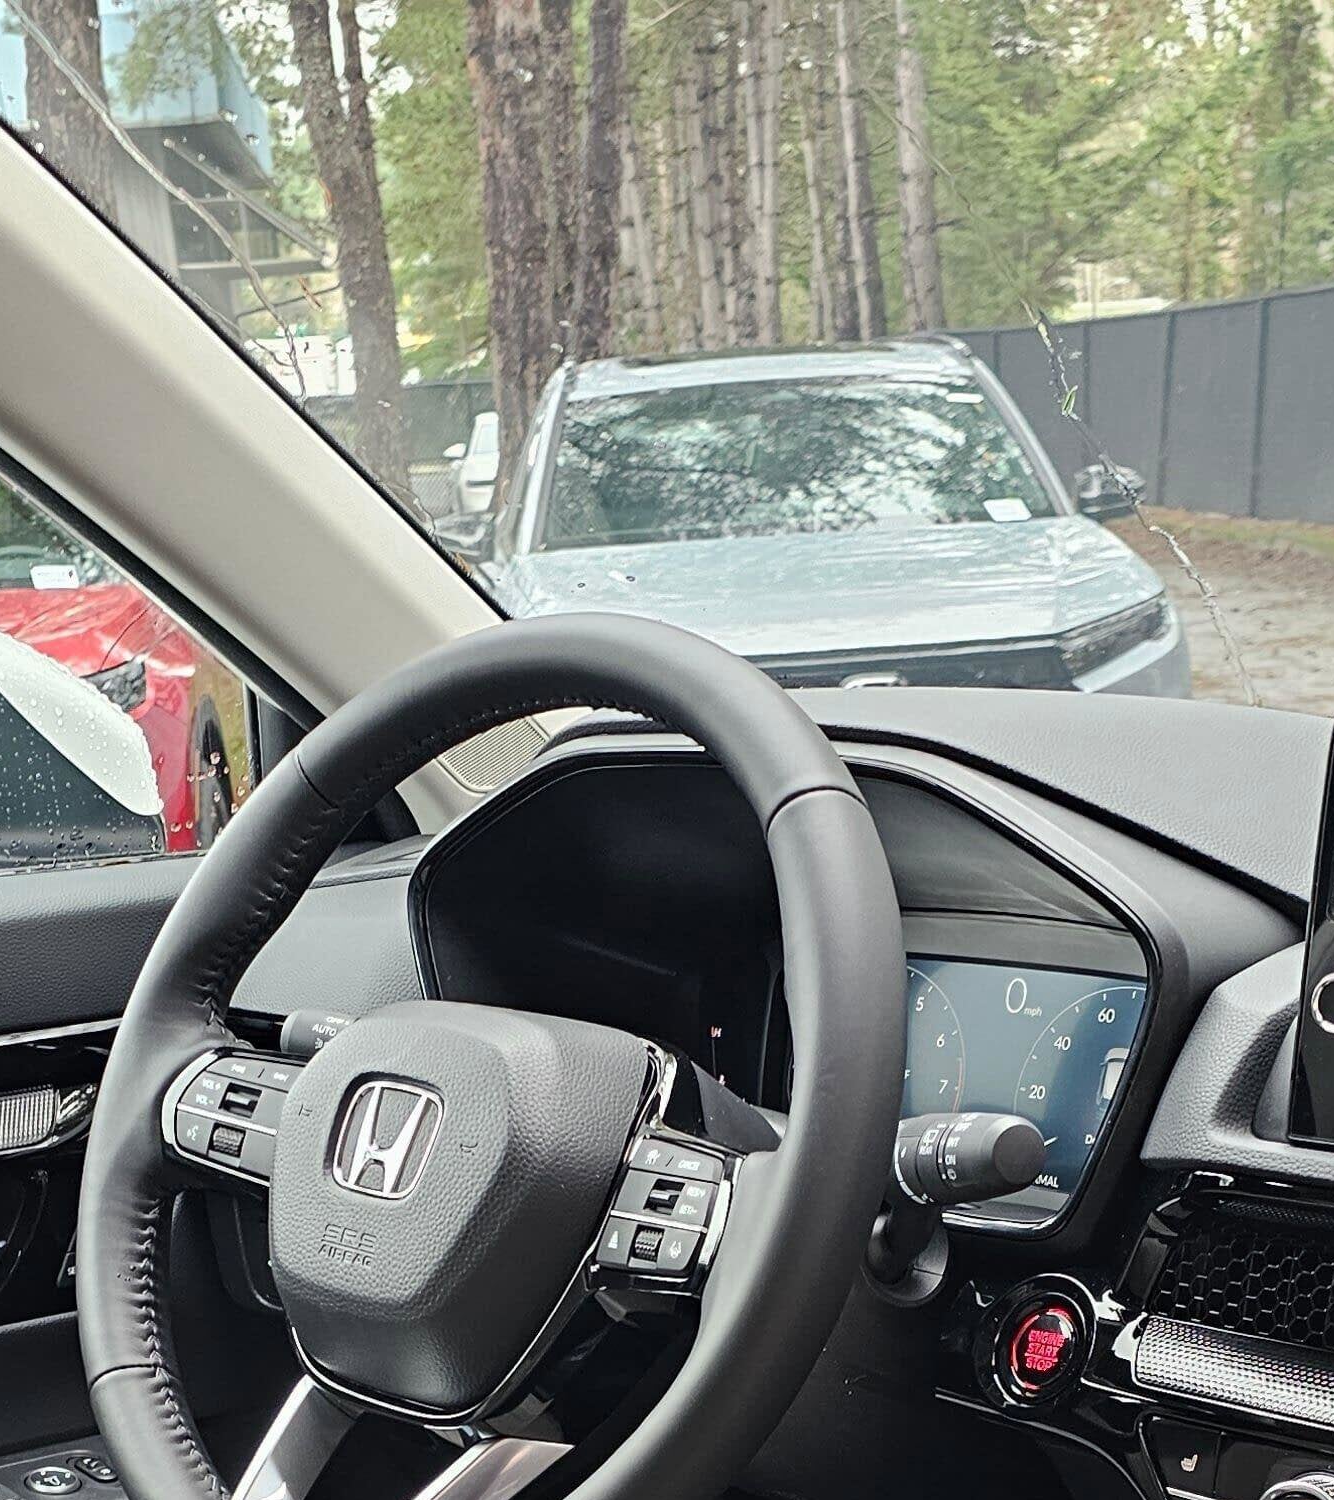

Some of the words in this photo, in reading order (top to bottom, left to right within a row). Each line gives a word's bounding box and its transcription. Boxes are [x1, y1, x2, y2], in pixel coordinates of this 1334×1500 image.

[915, 996, 925, 1012] 5
[1005, 978, 1028, 1014] 0
[1024, 1006, 1043, 1018] mph
[1097, 1007, 1116, 1024] 60
[312, 1023, 337, 1036] AUTO
[936, 1033, 946, 1048] 6
[1053, 1036, 1072, 1051] 40
[938, 1080, 949, 1094] 7
[1028, 1084, 1046, 1100] 20
[1028, 1330, 1065, 1347] ENGINE
[1027, 1343, 1060, 1358] START
[1026, 1357, 1054, 1371] STOP
